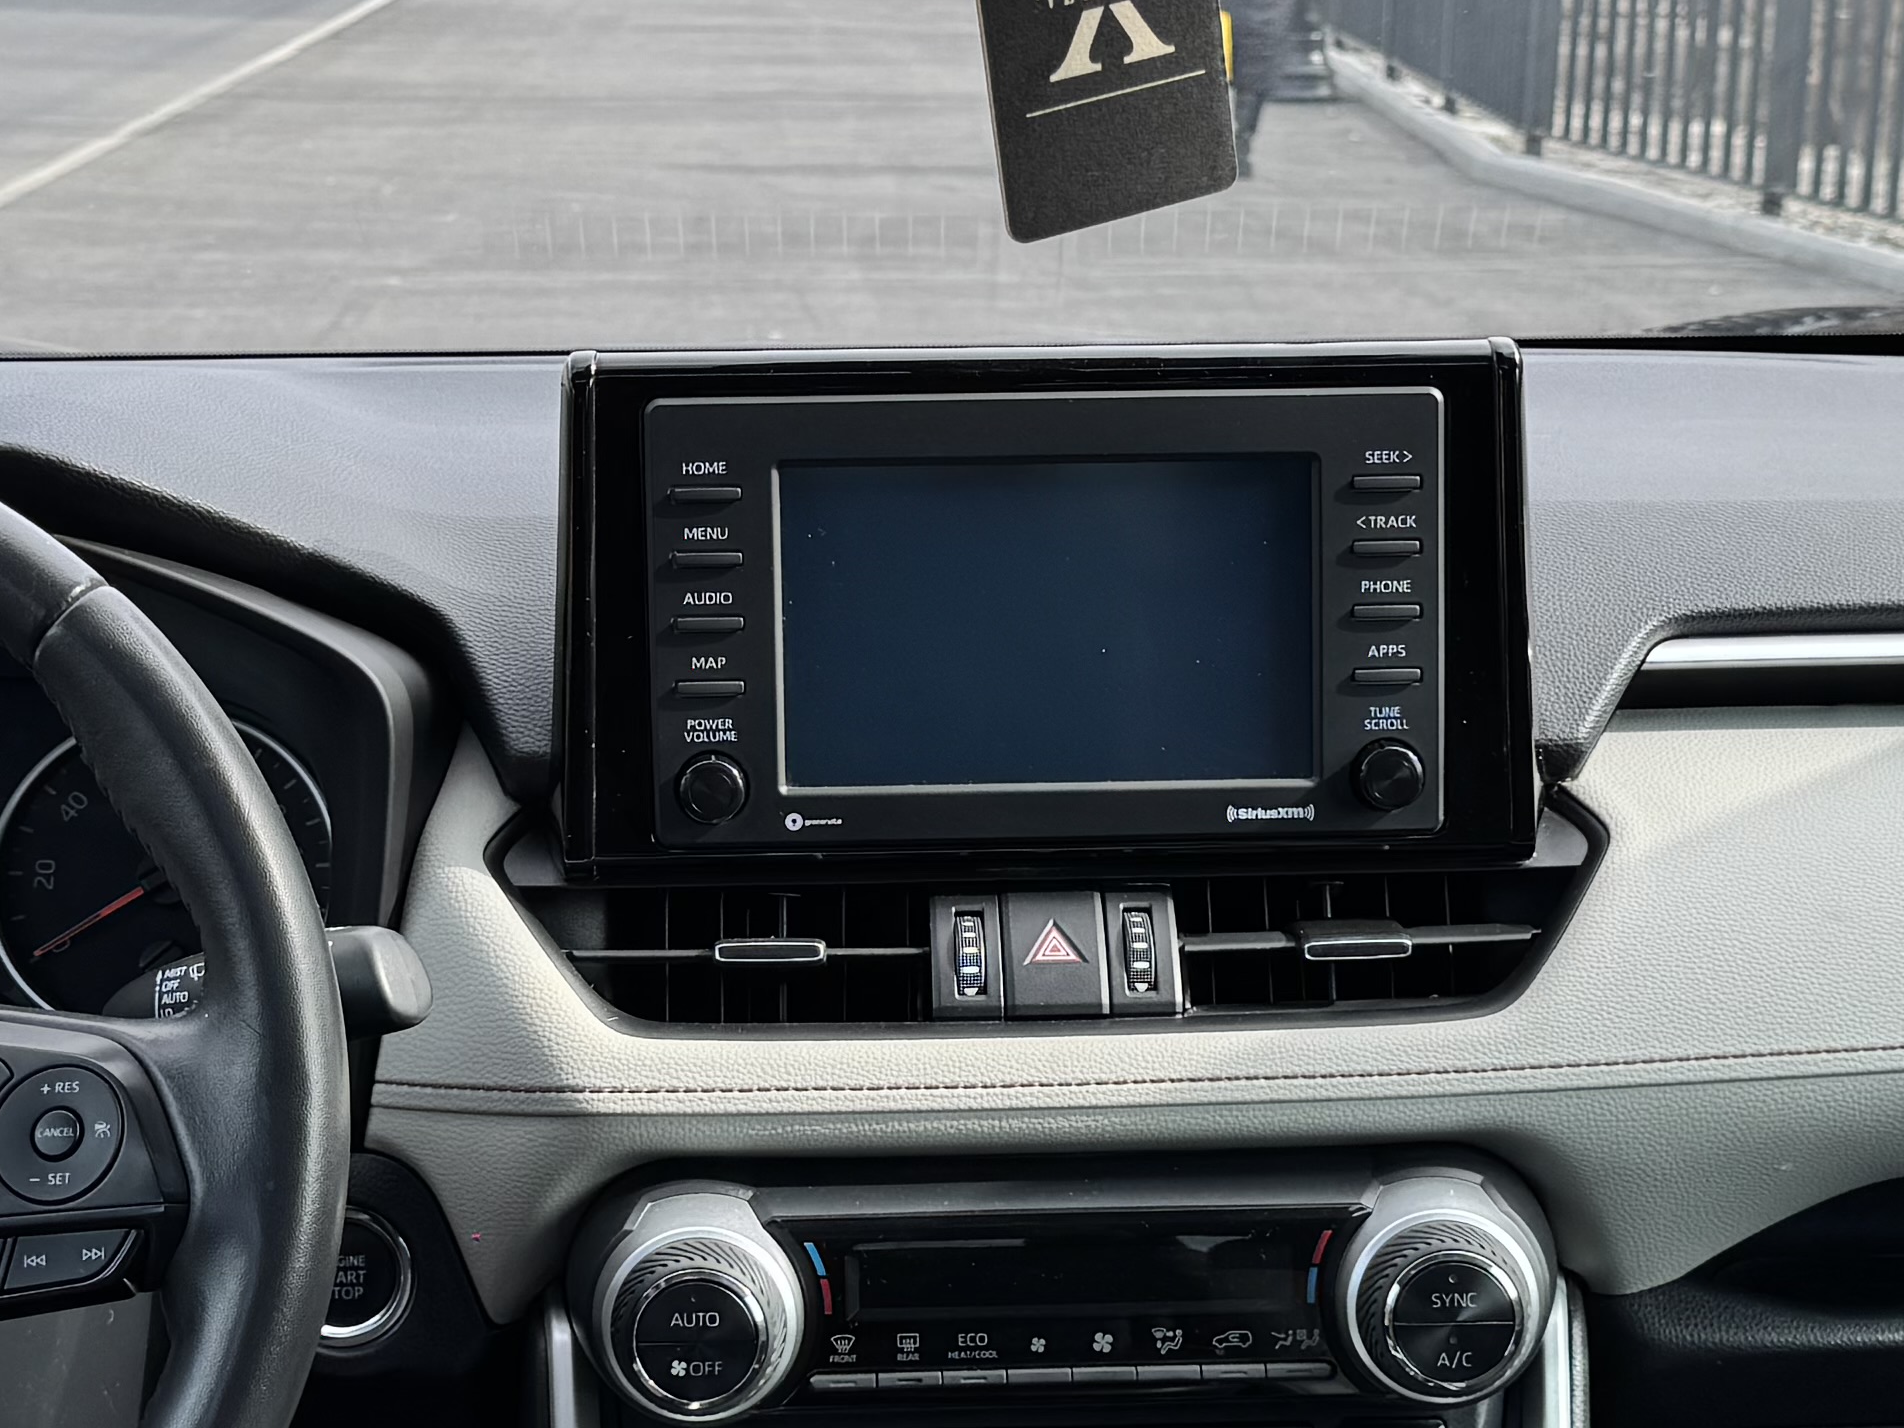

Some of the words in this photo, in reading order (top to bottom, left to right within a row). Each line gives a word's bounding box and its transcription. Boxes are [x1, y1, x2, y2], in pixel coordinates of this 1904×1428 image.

[1365, 451, 1400, 464] SEEK
[682, 462, 727, 475] HOME
[1368, 515, 1417, 528] TRACK
[684, 527, 728, 540] MENU
[1361, 580, 1412, 593] PHONE
[683, 592, 733, 605] AUDIO
[1367, 644, 1406, 658] APPS
[691, 657, 726, 670] MAP
[1369, 706, 1402, 718] TUNE
[687, 719, 733, 730] POWER
[1364, 719, 1410, 730] SCROLL
[684, 731, 738, 742] VOLUME
[58, 790, 90, 822] 40
[32, 858, 56, 890] 20
[161, 978, 181, 992] OFF
[161, 991, 189, 1005] AUTO
[54, 1081, 80, 1094] RES
[37, 1126, 75, 1139] CANCEL
[48, 1173, 71, 1185] SET
[337, 1255, 365, 1267] GINE
[336, 1270, 366, 1283] ART
[333, 1286, 363, 1299] TOP
[1431, 1292, 1477, 1308] SYNC
[670, 1311, 720, 1328] AUTO
[958, 1333, 988, 1346] ECO
[829, 1354, 856, 1363] FRONT
[897, 1352, 919, 1361] REAR
[948, 1350, 998, 1360] HEAT/COOL
[1437, 1351, 1472, 1368] A/C
[689, 1360, 723, 1376] OFF
